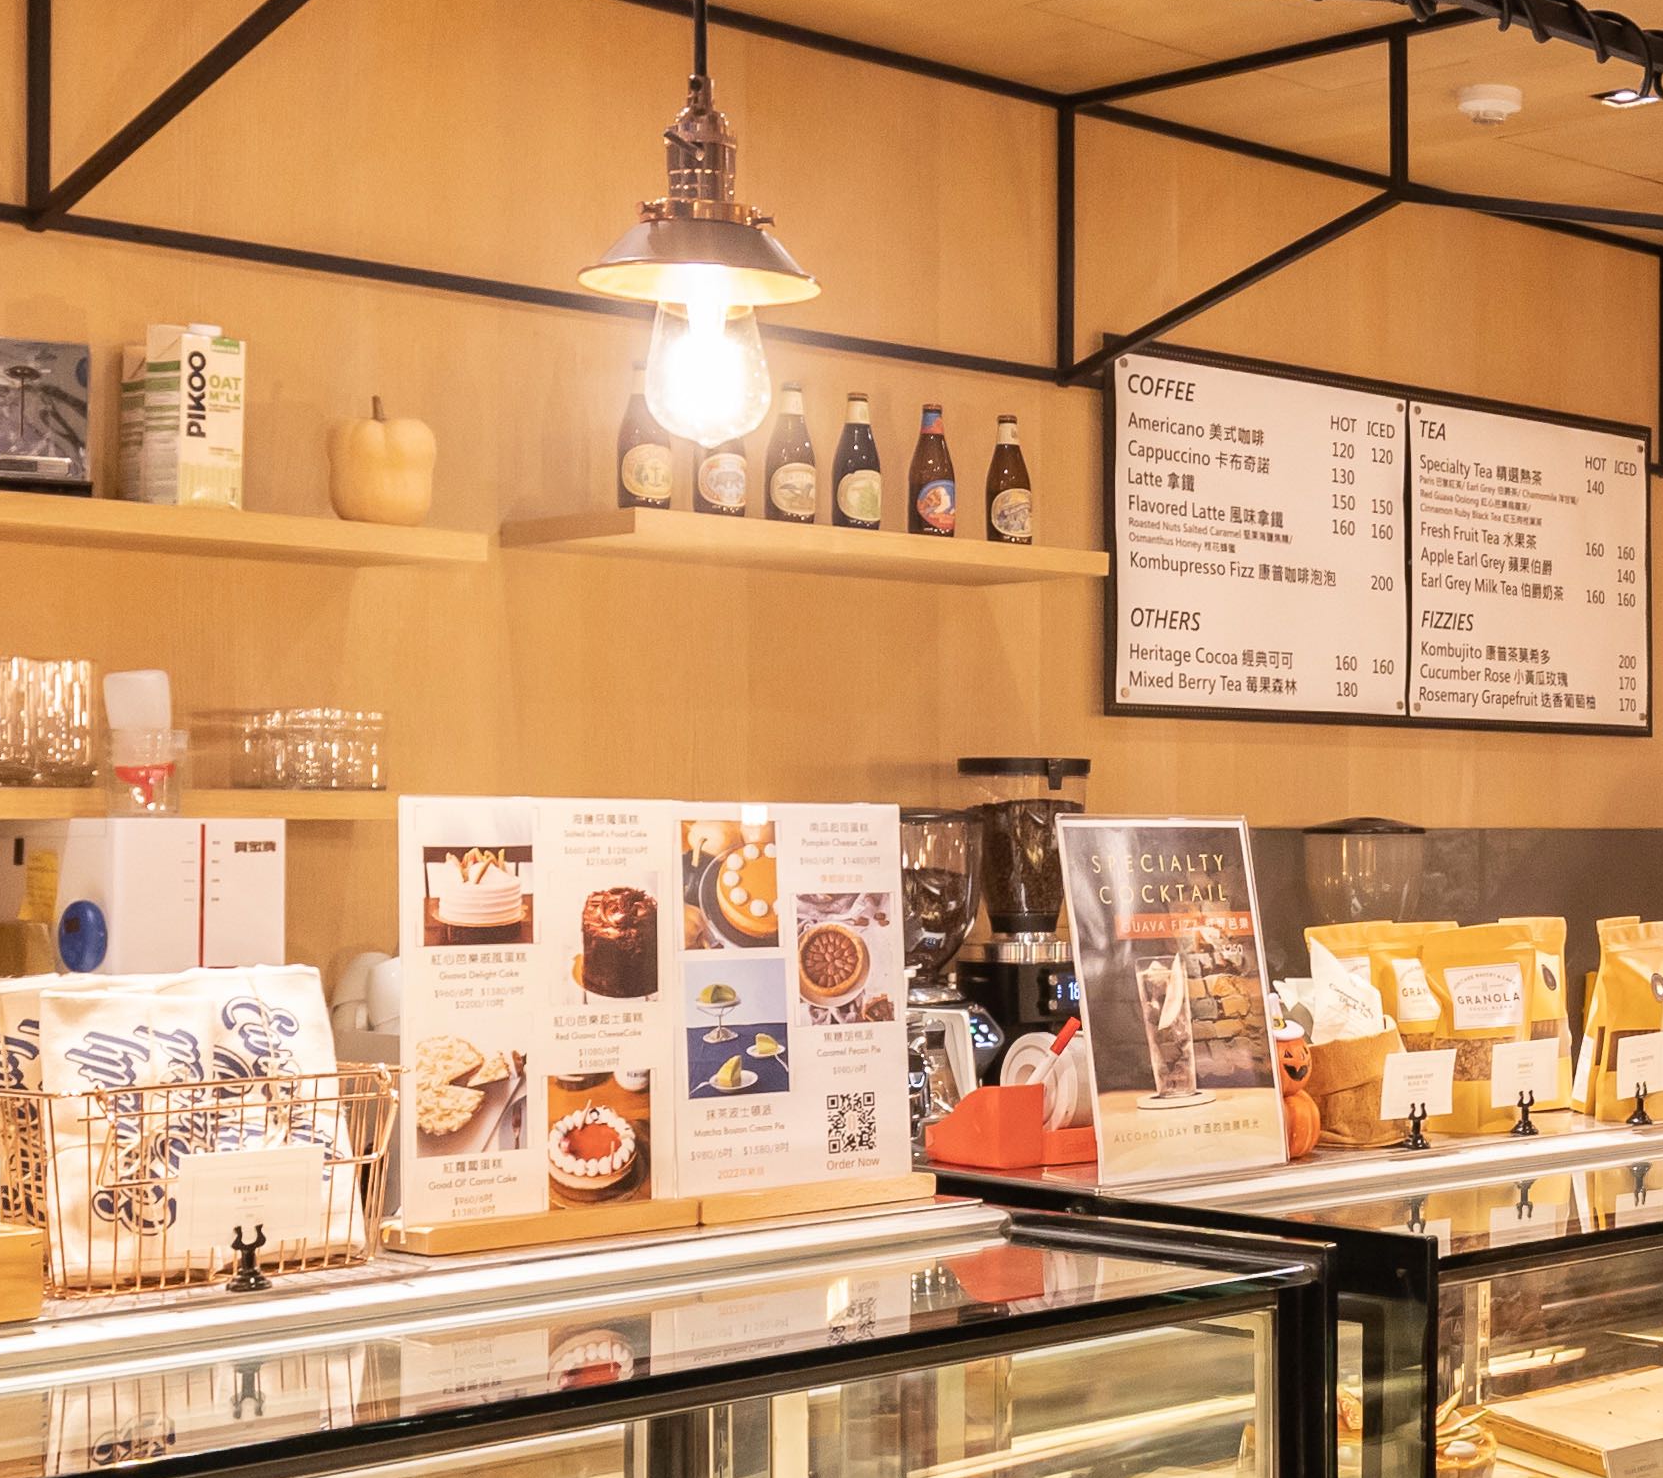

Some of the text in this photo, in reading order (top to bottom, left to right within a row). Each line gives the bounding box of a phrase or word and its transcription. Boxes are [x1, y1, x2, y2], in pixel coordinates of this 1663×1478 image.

[187, 351, 206, 438] PIKOO
[209, 375, 241, 390] OAT
[1128, 374, 1196, 402] COFFEE
[1128, 412, 1393, 464] Americano 美式咖啡 120 120
[1331, 415, 1395, 439] HOT ICED
[1420, 420, 1446, 441] TEA
[1128, 440, 1355, 485] Cappuccino 卡布奇諾 130
[1420, 455, 1470, 479] Specialty
[1473, 463, 1492, 478] Tea
[1586, 480, 1604, 494] 140
[1585, 456, 1637, 476] HOT ICED
[1128, 468, 1162, 487] Latte
[1331, 494, 1355, 511] 150
[1371, 499, 1393, 515] 150
[1466, 482, 1479, 491] Earl
[1481, 484, 1495, 495] Grey
[1128, 495, 1393, 540] Flavored Latte 風味拿鐵 160 160
[1128, 517, 1241, 539] Roasted Nuts Salted Caramel
[1129, 532, 1201, 553] Osmanthus Honey
[1421, 522, 1635, 560] Fresh Fruit Tea 水果茶 160 160
[1130, 551, 1393, 591] Kombupresso Fizz 康普咖啡泡泡 200
[1421, 547, 1454, 565] Apple
[1457, 551, 1477, 566] Earl
[1481, 553, 1505, 573] Grey
[1617, 569, 1635, 584] 140
[1421, 573, 1442, 588] Earl
[1445, 575, 1471, 595] Grey
[1475, 579, 1497, 594] Milk
[1501, 581, 1517, 596] Tea
[1586, 590, 1605, 604] 160
[1618, 593, 1635, 607] 160
[1131, 607, 1200, 631] OTHERS
[1421, 611, 1474, 631] FIZZIES
[1129, 643, 1394, 675] Heritage Cocoa 經典可可 160 160
[1421, 641, 1482, 662] Kombujito
[1618, 655, 1636, 669] 200
[1129, 671, 1173, 689] Mixed
[1178, 673, 1216, 694] Berry
[1220, 676, 1242, 692] Tea
[1336, 682, 1358, 697] 180
[1420, 664, 1481, 681] Cucumber
[1485, 668, 1511, 683] Rose
[1619, 677, 1636, 690] 170
[1419, 687, 1479, 705] Rosemary
[1482, 690, 1538, 708] Grapefruit
[1619, 698, 1636, 712] 170
[1091, 854, 1224, 874] SPECIALTY
[1099, 885, 1227, 905] COCKTAIL
[1120, 920, 1165, 933] GUAVA
[1457, 992, 1521, 1005] GRANOLA
[1114, 1128, 1188, 1143] ALCOHOLIDAY
[827, 1157, 879, 1170] Order Now
[428, 1181, 453, 1191] Good
[497, 1175, 517, 1183] Cake
